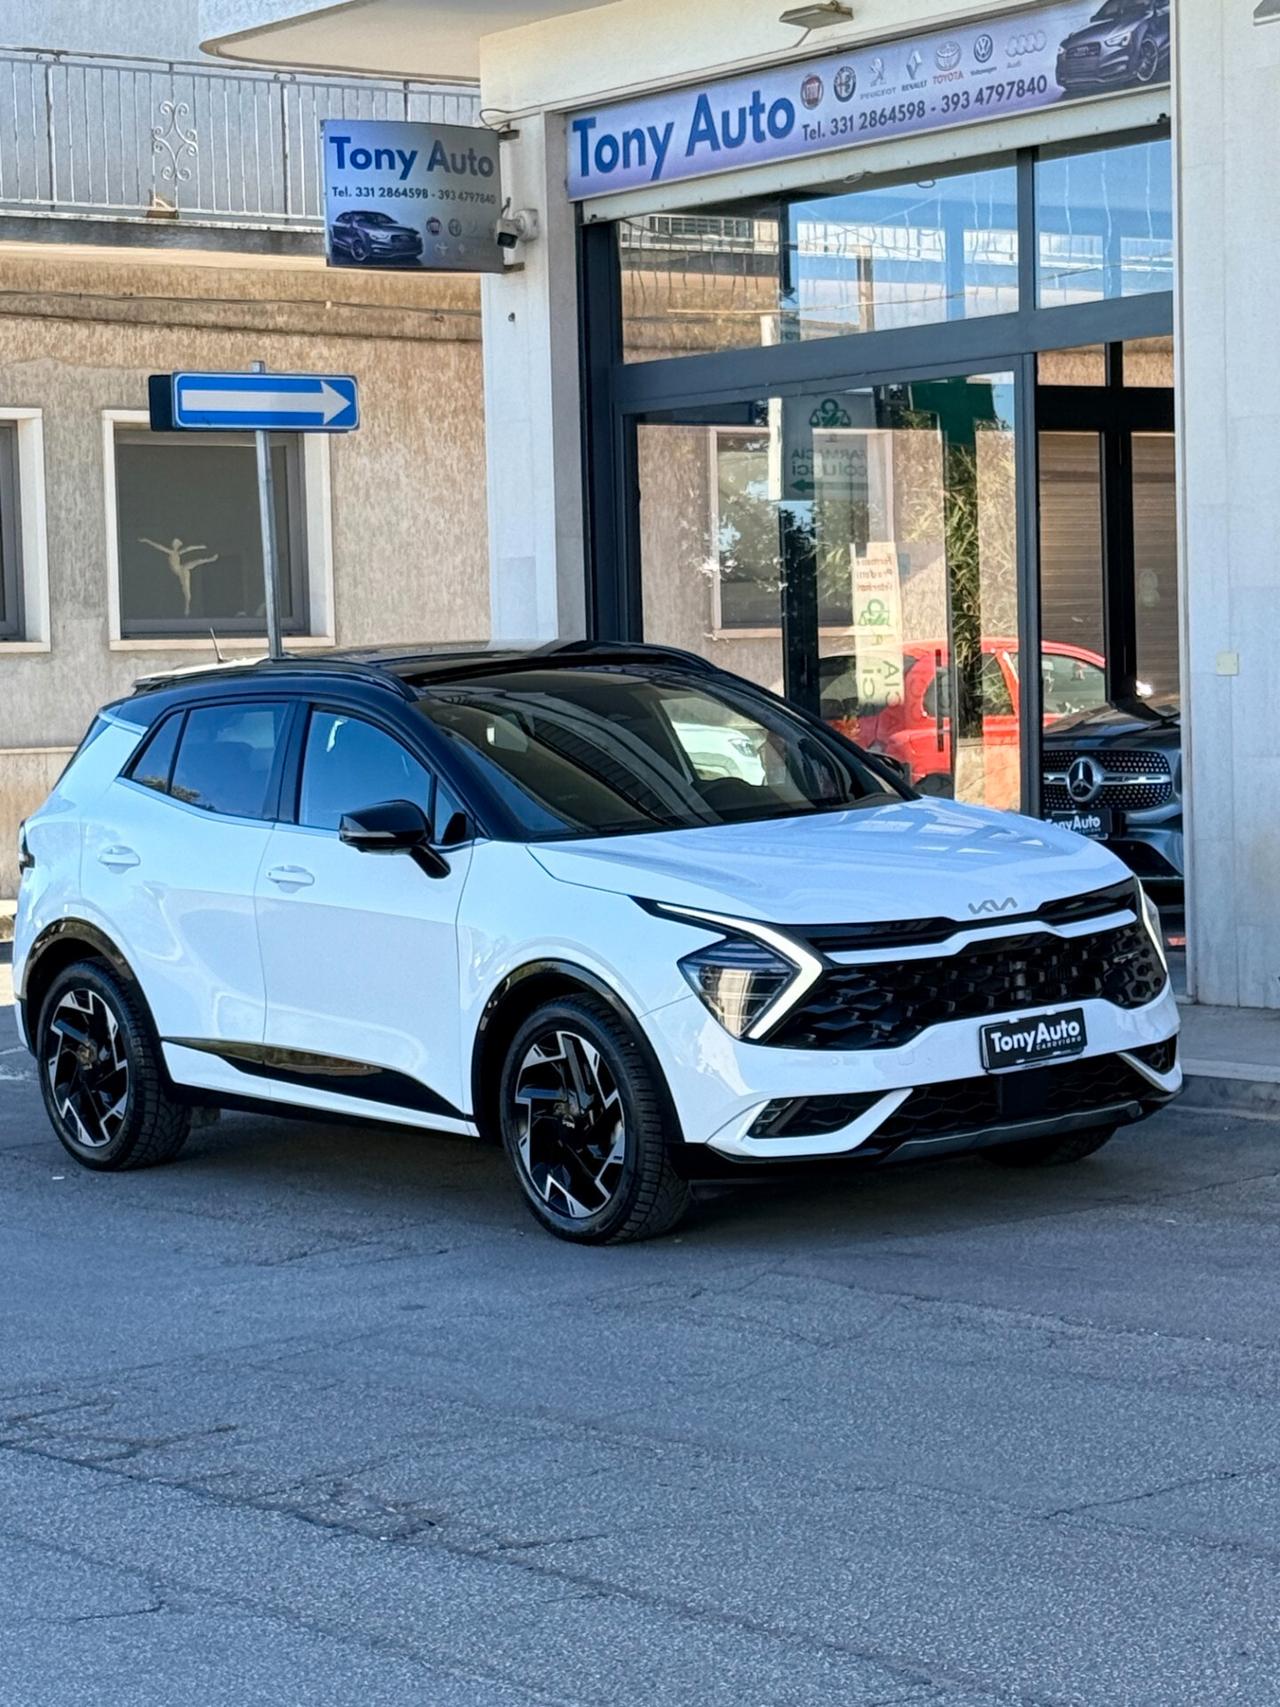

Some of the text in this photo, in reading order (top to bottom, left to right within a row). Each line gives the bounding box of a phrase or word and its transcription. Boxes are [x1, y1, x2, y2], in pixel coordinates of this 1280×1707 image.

[932, 70, 964, 85] TOYOTA
[802, 122, 826, 141] Tel.
[830, 115, 854, 135] 331
[858, 102, 927, 131] 2864598
[941, 92, 971, 114] 393
[974, 75, 1048, 106] 4797840
[572, 90, 795, 181] Tony Auto
[329, 136, 495, 180] Tony Auto
[332, 186, 352, 198] Tel.
[355, 187, 375, 198] 331
[379, 187, 429, 199] 2864598
[438, 189, 457, 201] 393
[1046, 815, 1101, 830] nyAuto
[990, 1020, 1080, 1053] TonyAuto
